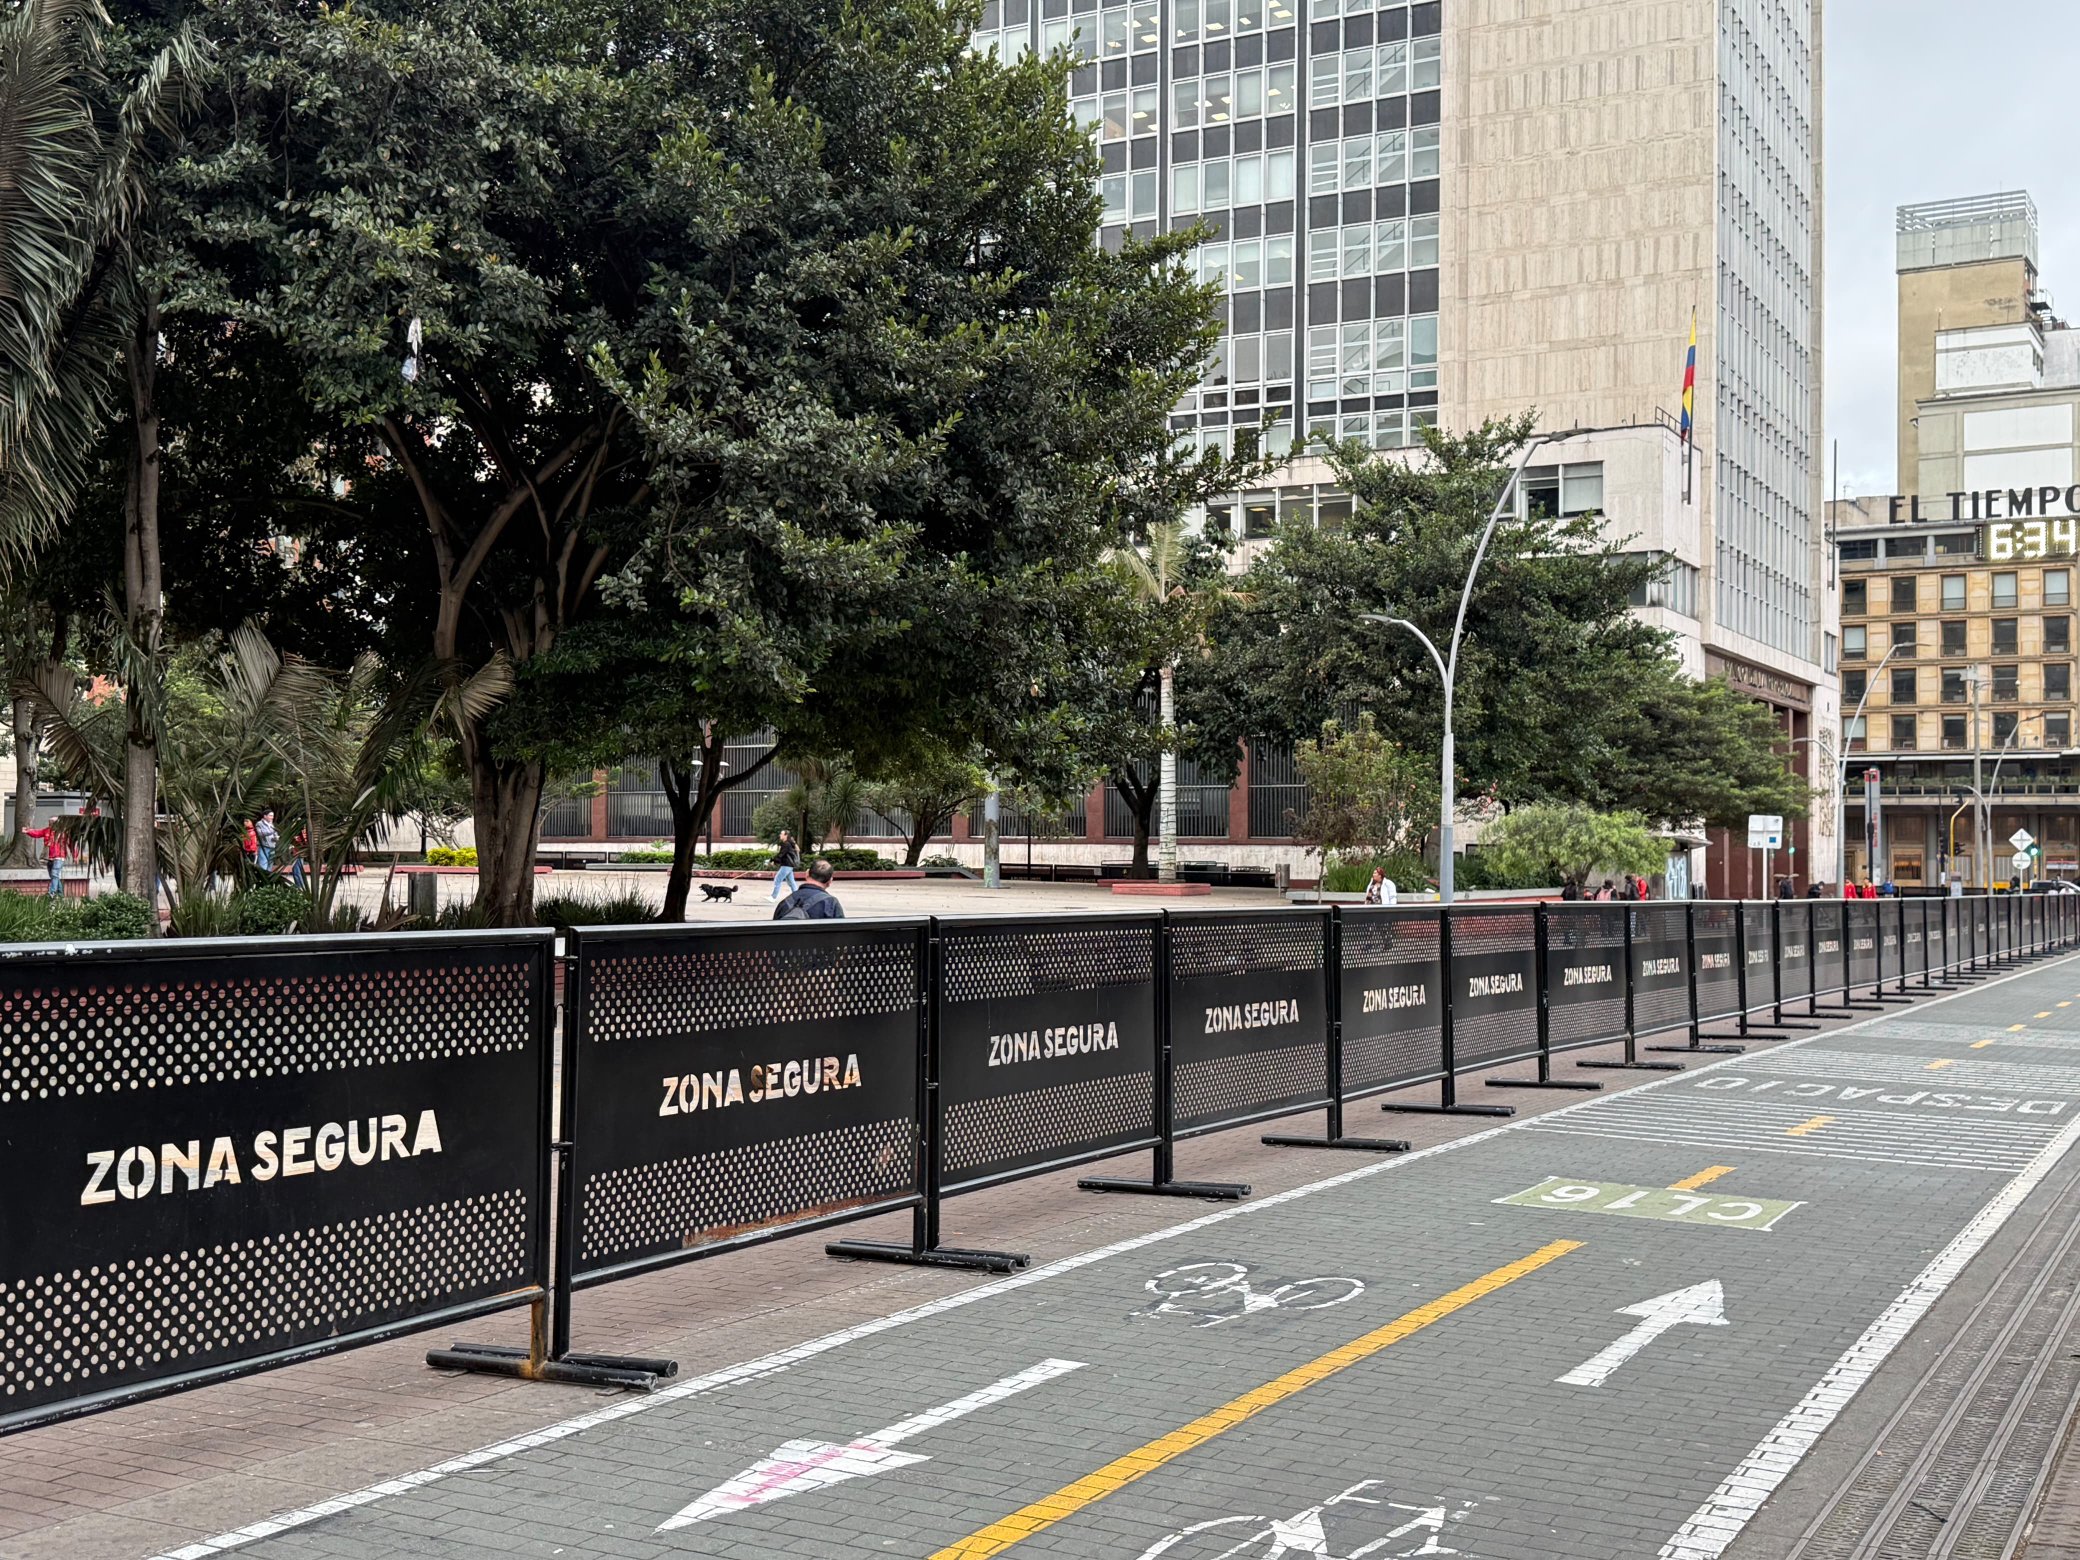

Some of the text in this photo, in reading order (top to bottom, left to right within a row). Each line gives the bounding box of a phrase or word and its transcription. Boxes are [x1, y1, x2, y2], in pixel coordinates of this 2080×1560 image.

[1889, 484, 2080, 524] EL TIEMPO
[1990, 519, 2076, 560] 6:34
[1469, 973, 1523, 998] ZONA SEGURA
[1563, 965, 1612, 986] ZONA SEGURA
[1642, 959, 1656, 977] ZONA
[1204, 999, 1299, 1034] ZONA SEGURA
[1363, 984, 1426, 1013] ZONA SEGURA
[988, 1022, 1118, 1067] ZONA SEGURA
[659, 1054, 862, 1117] ZONA SEGURA
[1694, 1076, 2068, 1116] DESPACIO
[80, 1109, 442, 1206] ZONA SEGURA
